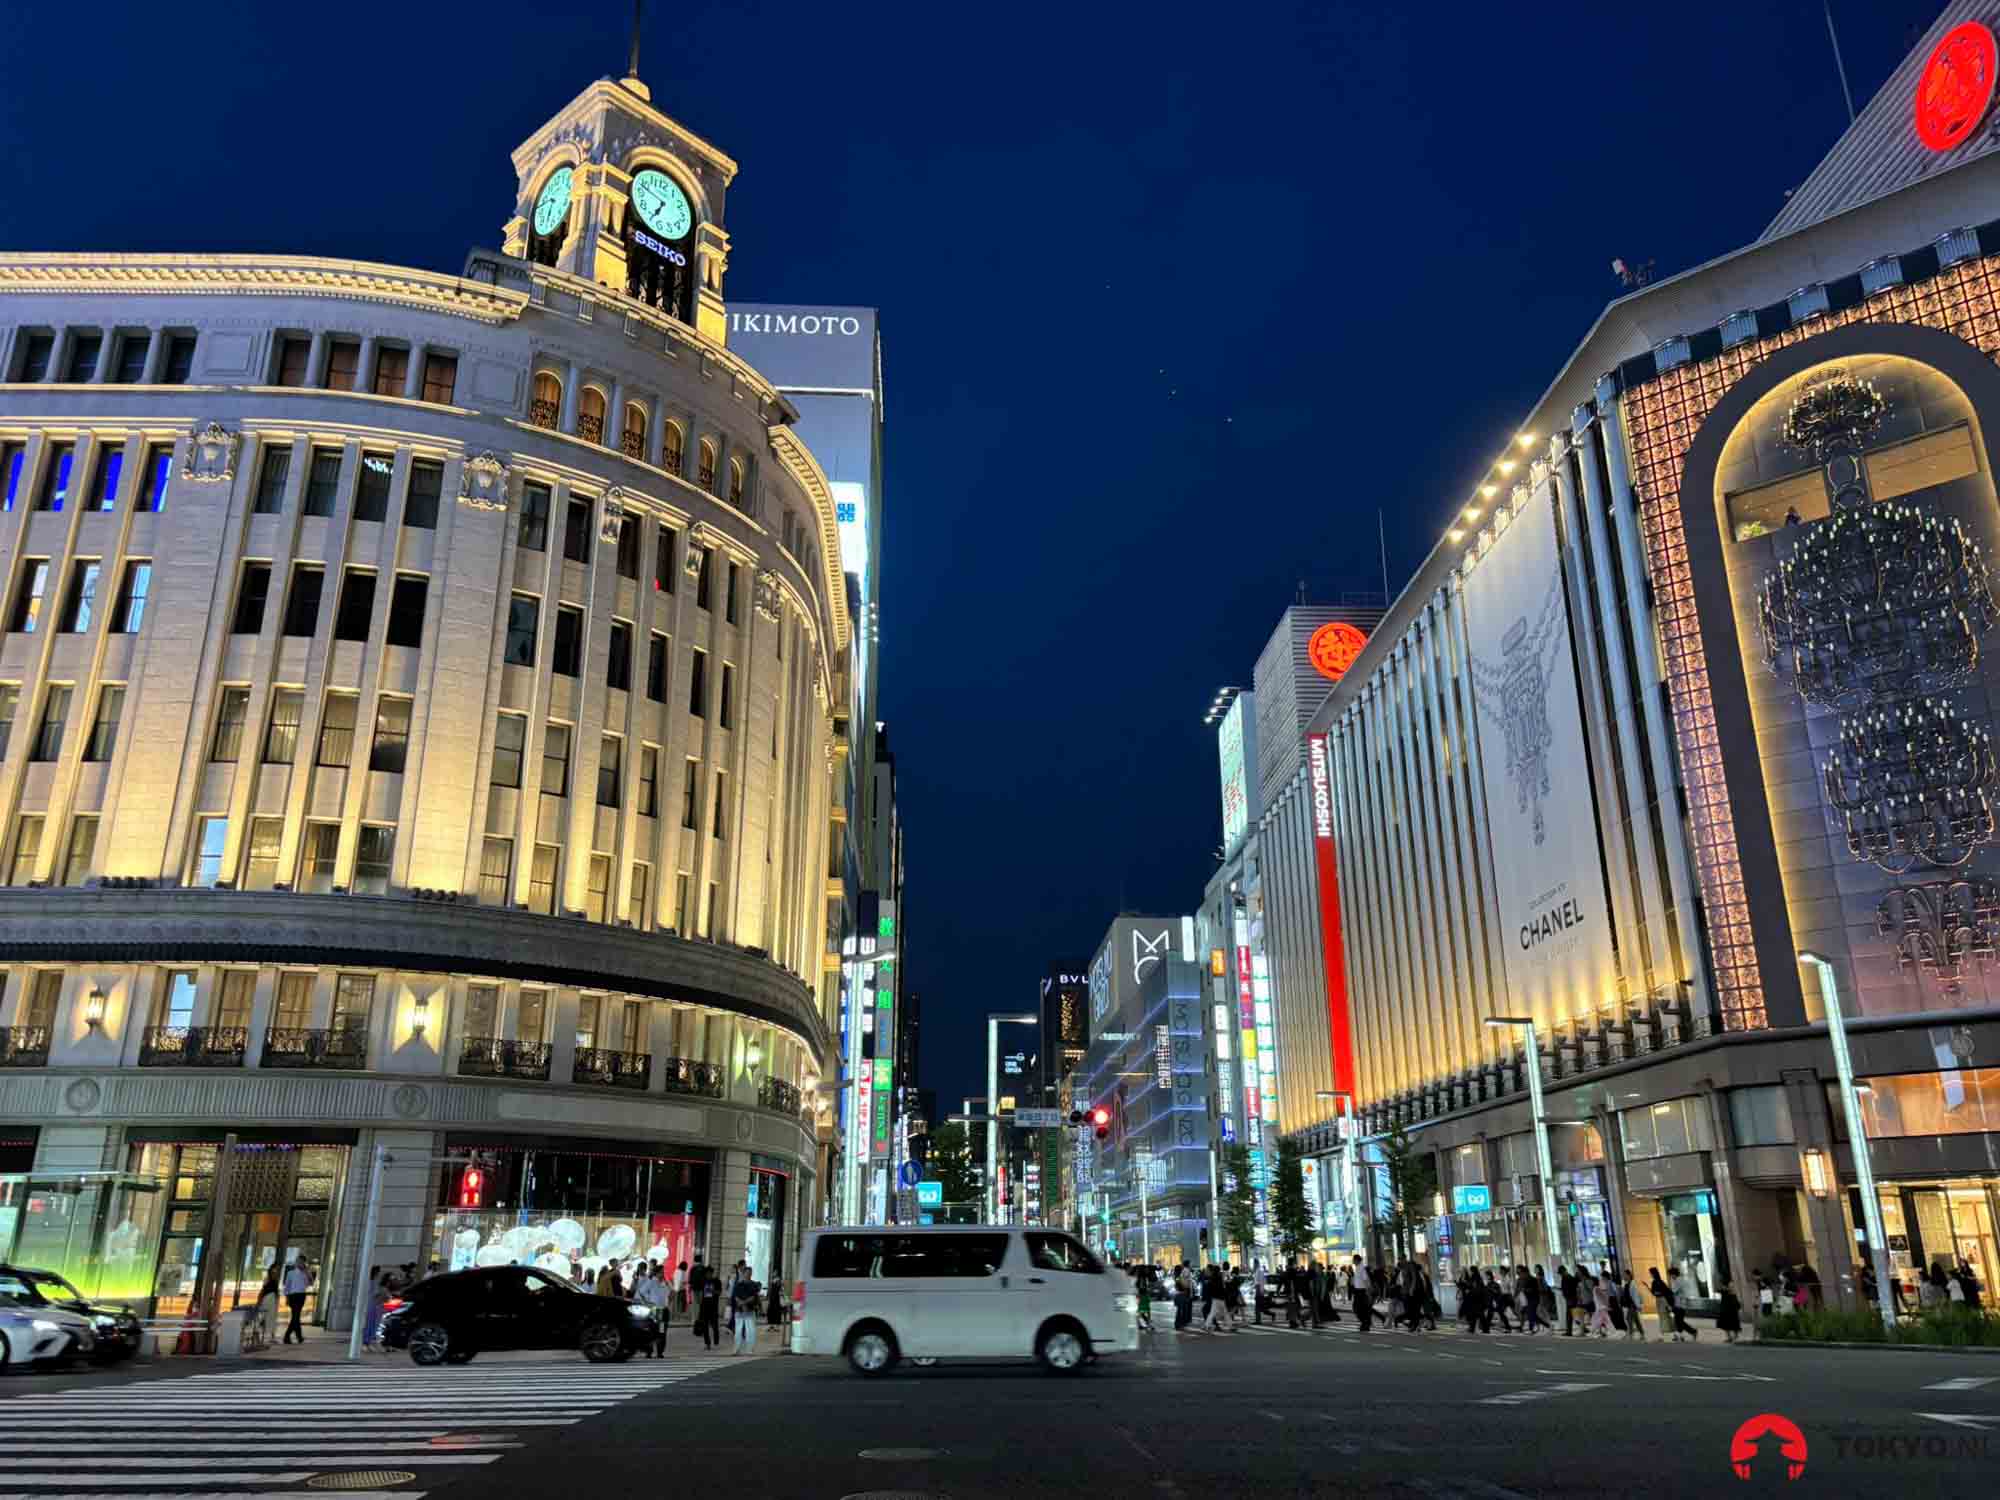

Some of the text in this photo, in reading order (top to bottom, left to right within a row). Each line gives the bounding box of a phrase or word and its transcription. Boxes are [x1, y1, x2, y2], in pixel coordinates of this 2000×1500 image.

[635, 230, 686, 266] SEIKO
[725, 312, 860, 336] IKIMOTO
[1311, 738, 1331, 837] MITSUKOSHI
[1520, 898, 1585, 950] CHANEL
